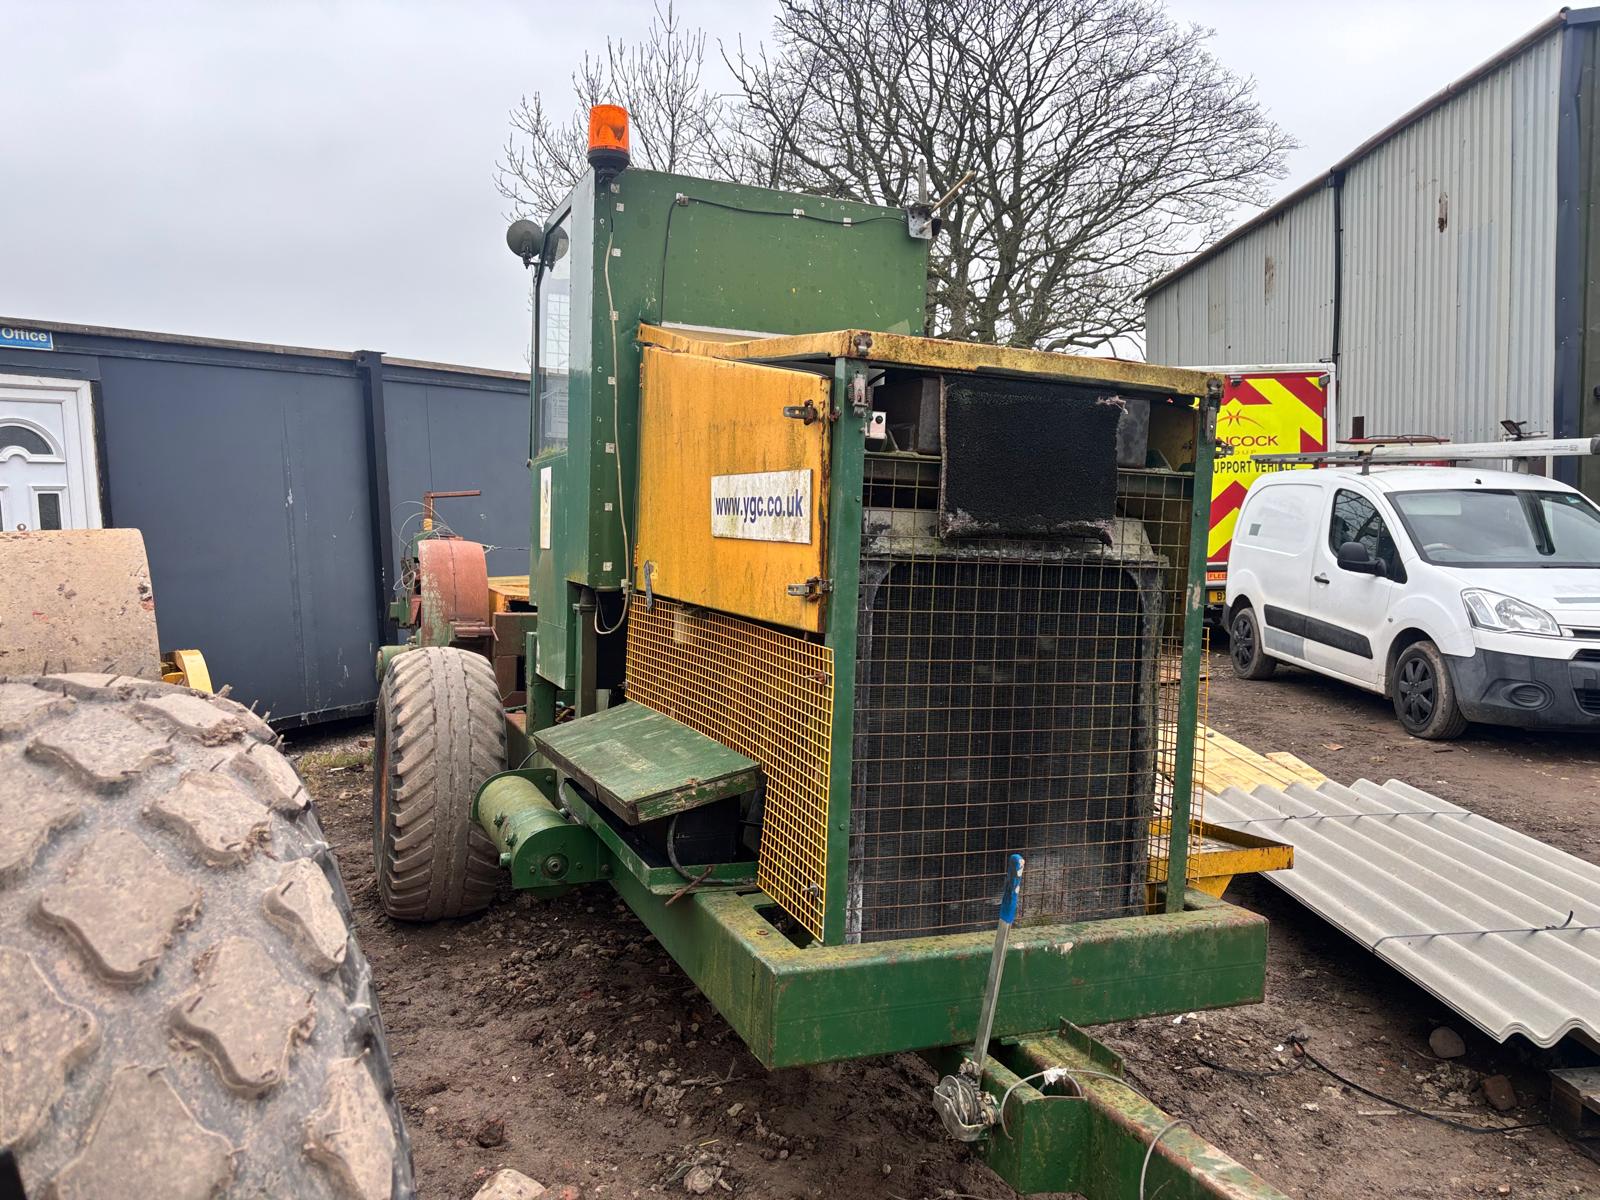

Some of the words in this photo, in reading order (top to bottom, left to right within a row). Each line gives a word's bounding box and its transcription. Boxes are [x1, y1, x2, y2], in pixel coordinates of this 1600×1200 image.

[1, 327, 48, 342] Office
[1213, 460, 1252, 474] UPPORT
[715, 489, 804, 523] www.ygc.co.uk
